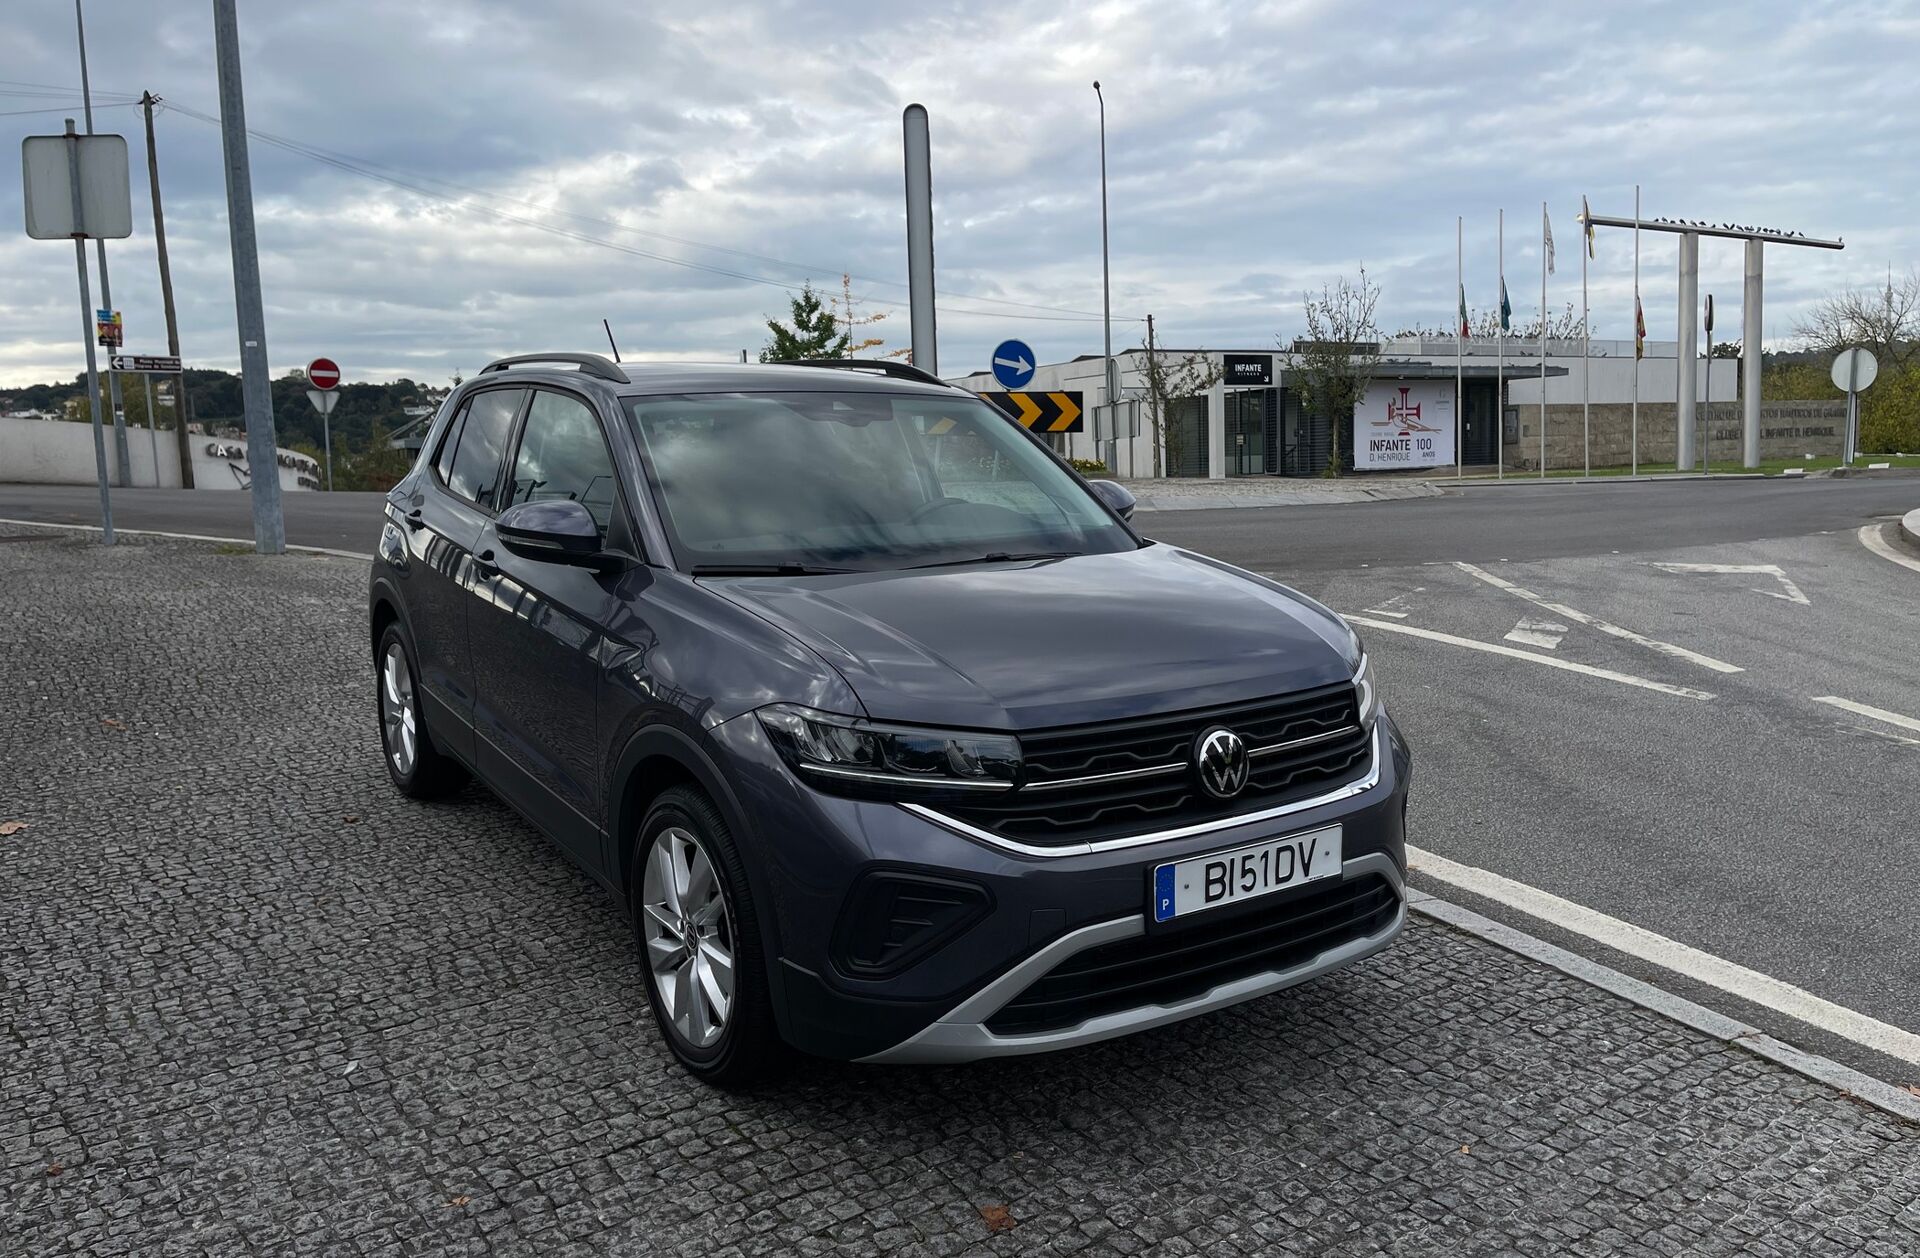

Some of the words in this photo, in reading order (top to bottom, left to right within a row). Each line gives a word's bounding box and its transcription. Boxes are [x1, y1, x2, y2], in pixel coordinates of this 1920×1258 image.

[1234, 363, 1262, 372] INFANTE
[1369, 439, 1411, 451] INFANTE
[1416, 438, 1432, 450] 100
[205, 443, 244, 459] CASA
[1377, 451, 1410, 462] HENRIQUE
[1421, 450, 1436, 458] ANOS
[1162, 898, 1170, 911] P
